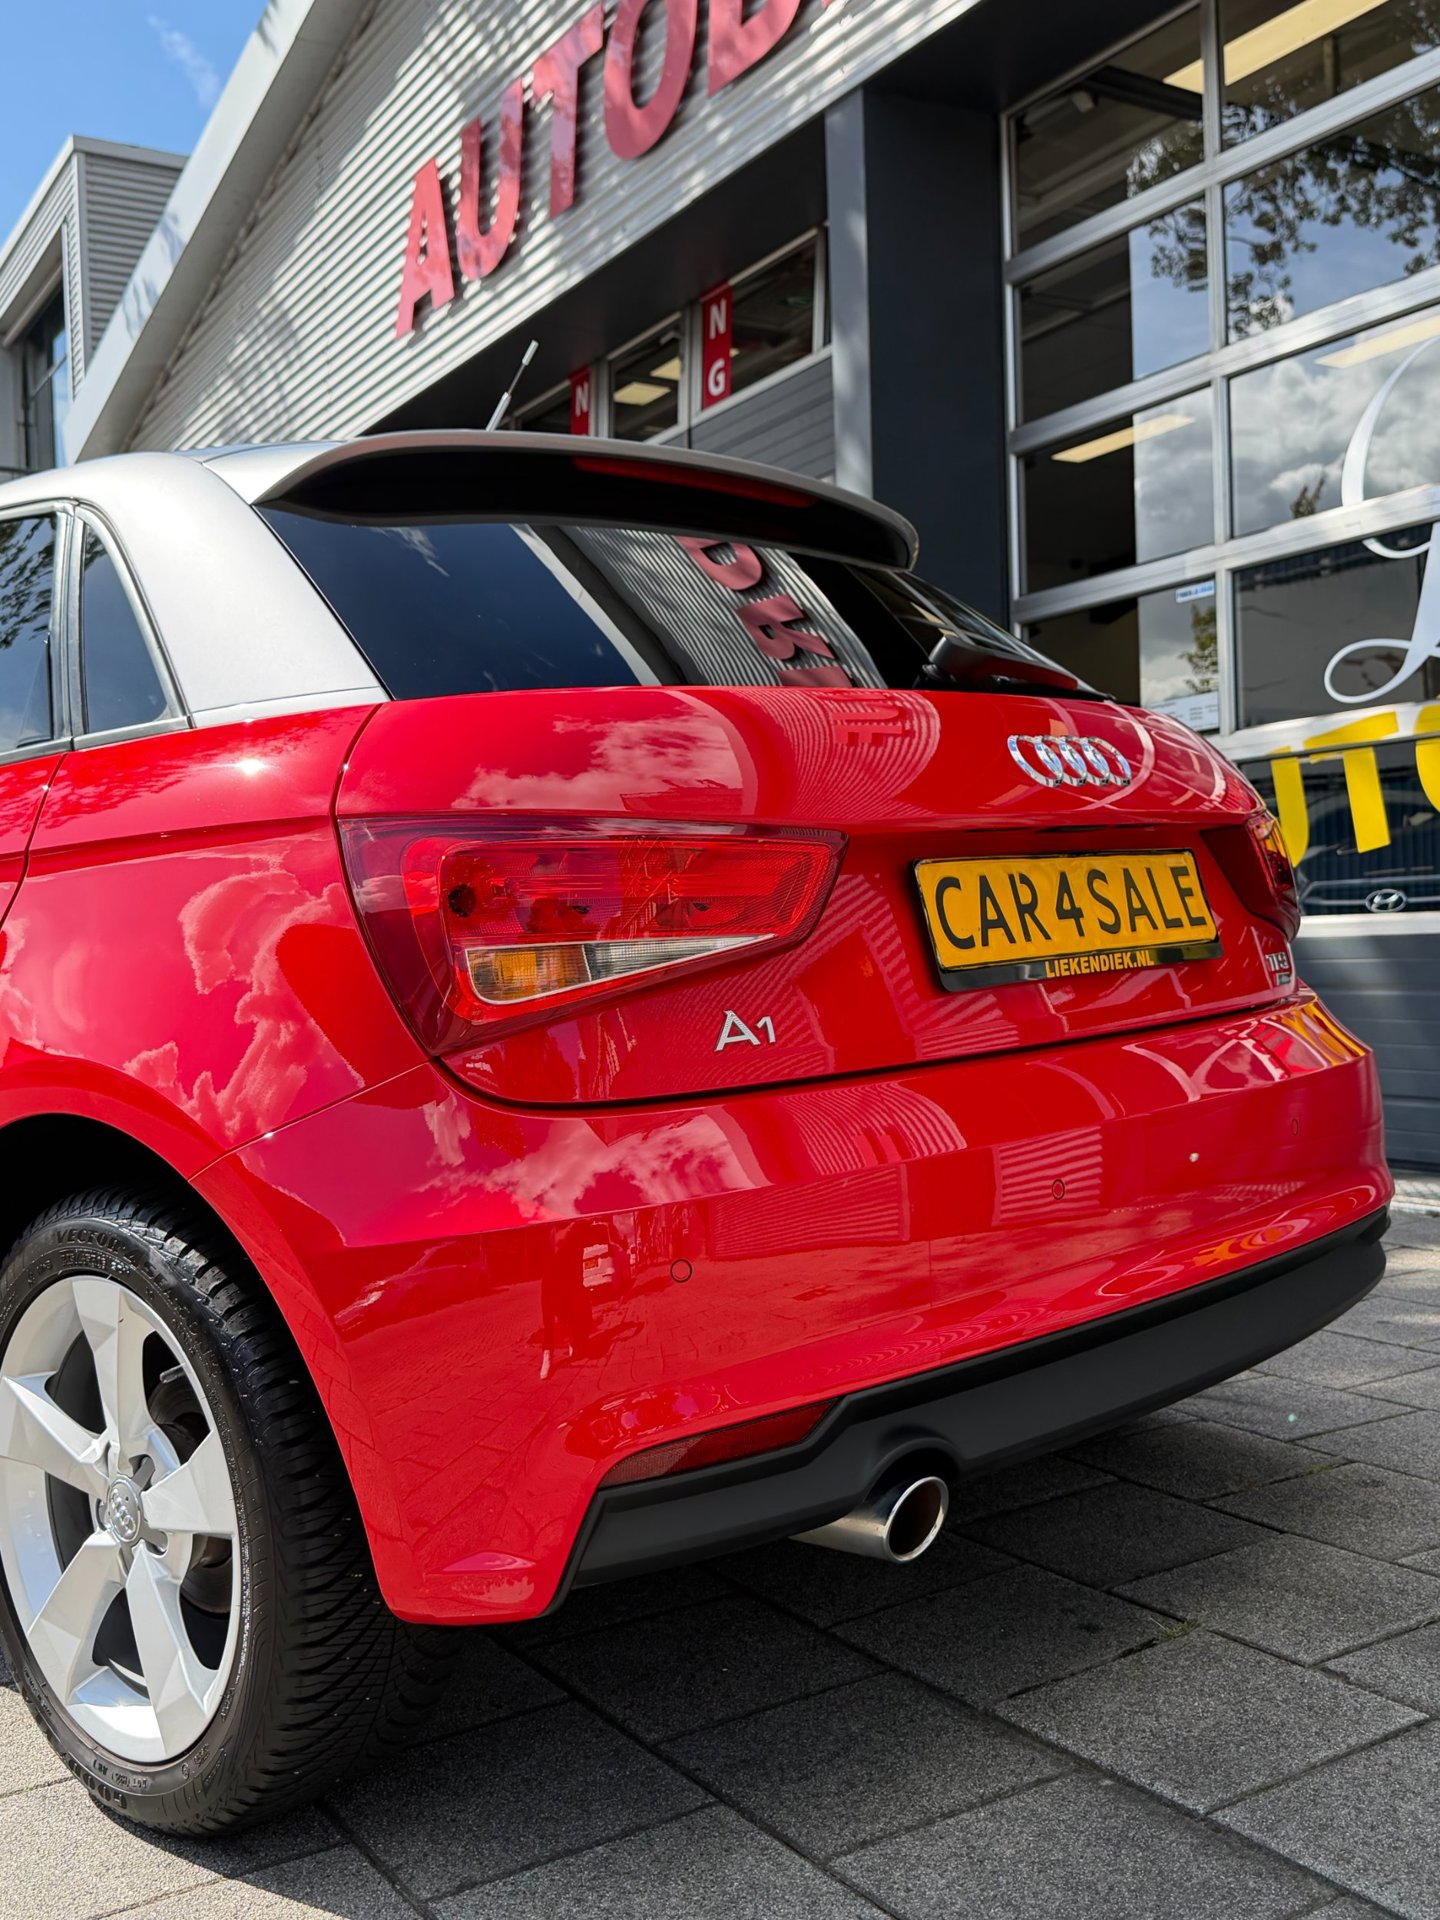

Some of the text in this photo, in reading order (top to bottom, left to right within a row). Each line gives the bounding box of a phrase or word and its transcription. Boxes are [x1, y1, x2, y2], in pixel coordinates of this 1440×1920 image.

[935, 865, 1207, 950] CAR4SALE
[1045, 951, 1155, 978] LIEKENDIEK.NL
[714, 1009, 776, 1052] A1
